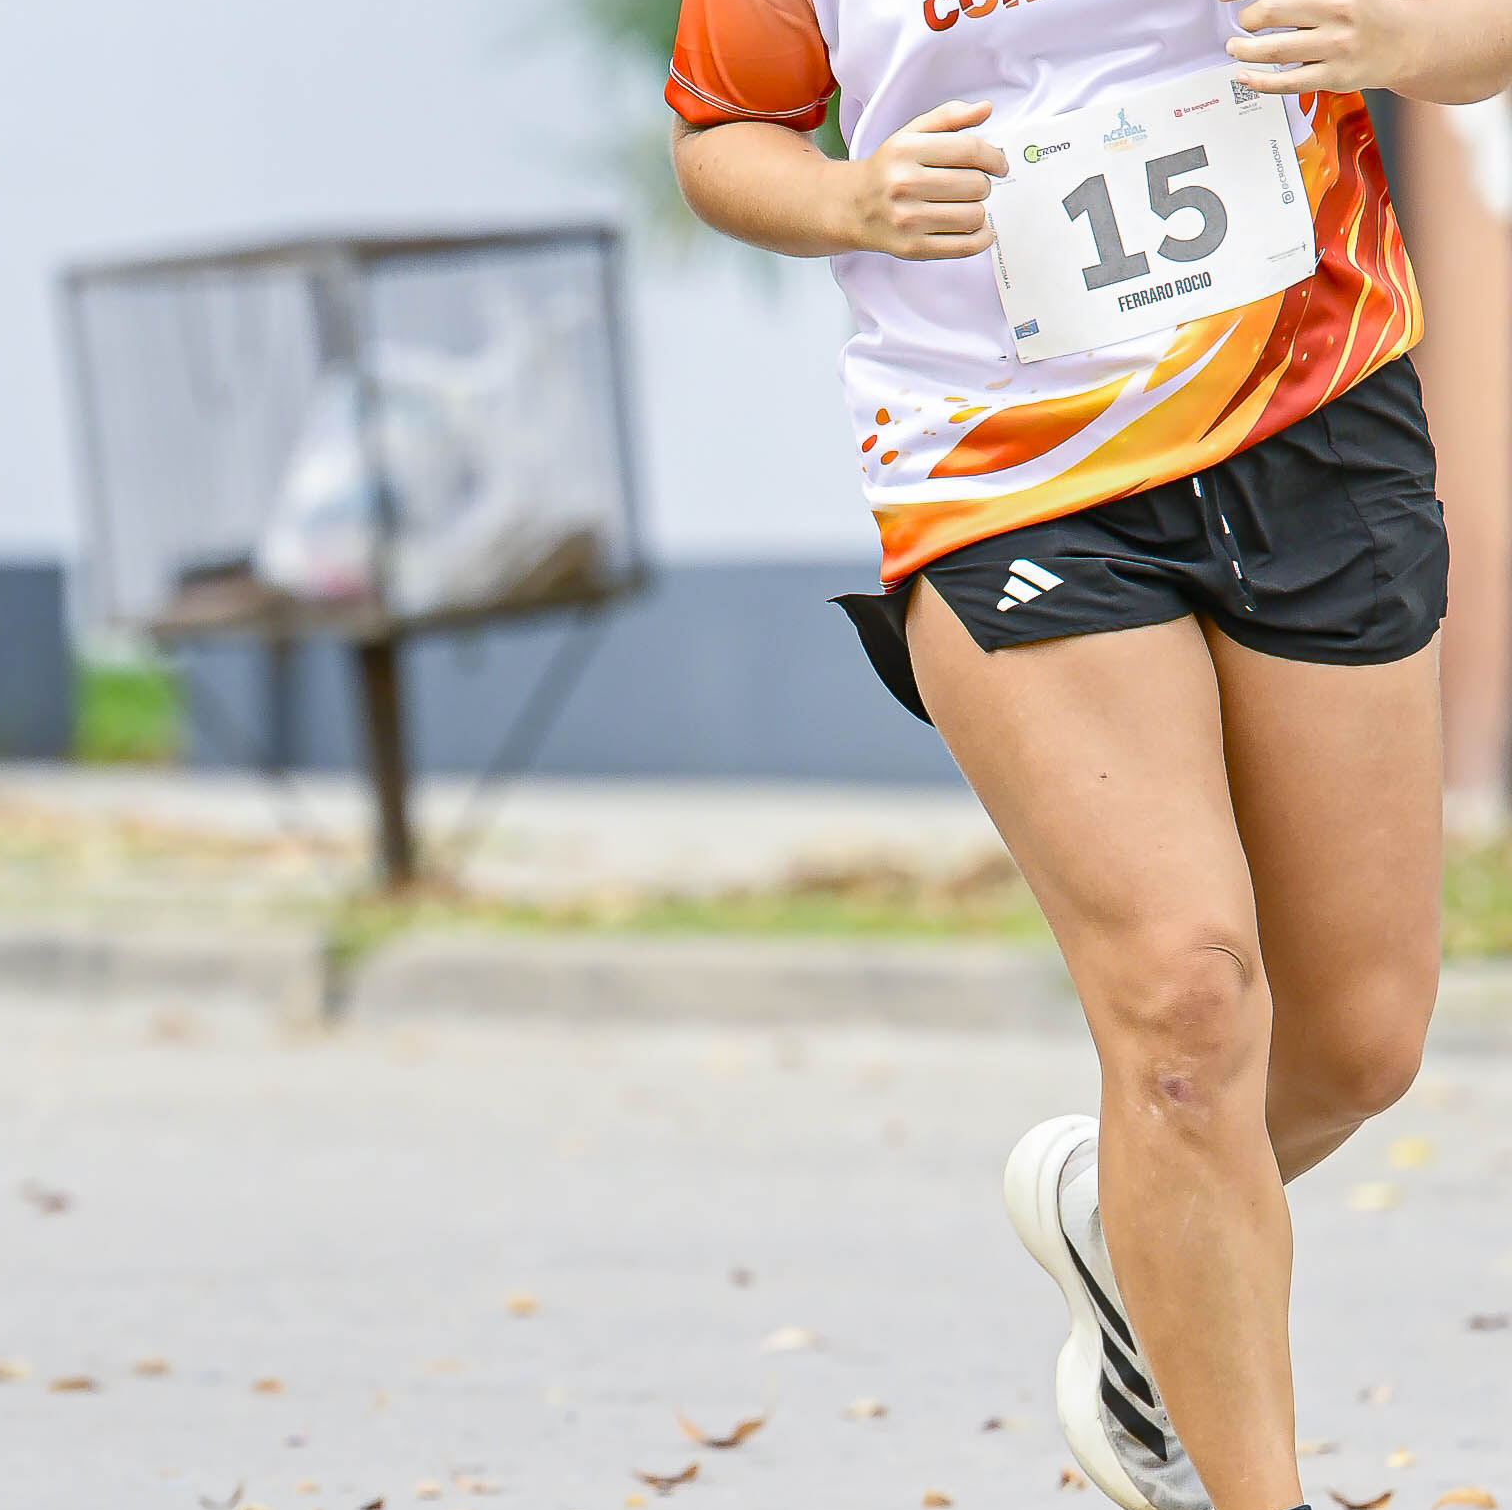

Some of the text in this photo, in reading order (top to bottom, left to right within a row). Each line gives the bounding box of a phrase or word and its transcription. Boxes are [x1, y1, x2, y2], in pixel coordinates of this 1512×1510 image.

[1061, 144, 1228, 292] 15
[1117, 271, 1213, 313] FERRARO ROCIO
